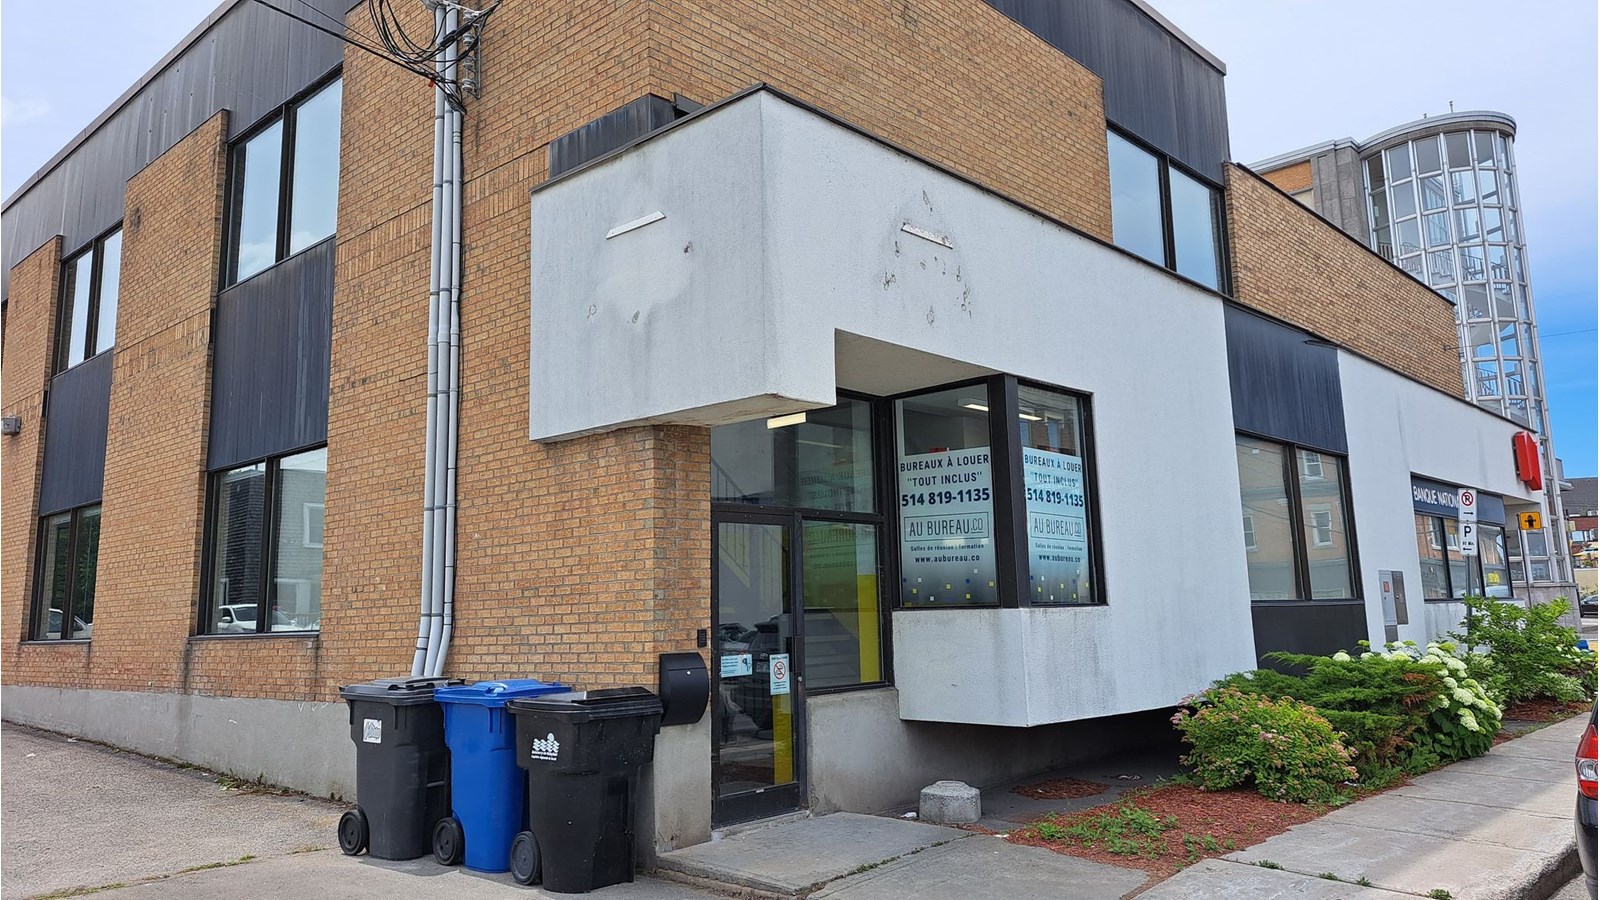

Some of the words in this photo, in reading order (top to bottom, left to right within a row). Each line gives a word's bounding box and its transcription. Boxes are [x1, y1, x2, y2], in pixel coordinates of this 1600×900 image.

[900, 459, 943, 472] BUREAUX
[947, 456, 953, 467] À
[957, 454, 989, 466] LOUER
[1025, 454, 1055, 468] BUREAUX
[1057, 458, 1061, 469] À
[1063, 461, 1082, 472] LOUER
[902, 493, 925, 507] 514
[928, 488, 990, 505] 819-1135
[1027, 487, 1044, 502] 514
[1046, 490, 1084, 507] 819-1135
[1413, 485, 1438, 505] BANQUE
[909, 521, 923, 537] AU
[1034, 517, 1044, 533] AU
[1464, 525, 1472, 537] P
[915, 554, 980, 563] www.aubureau.co
